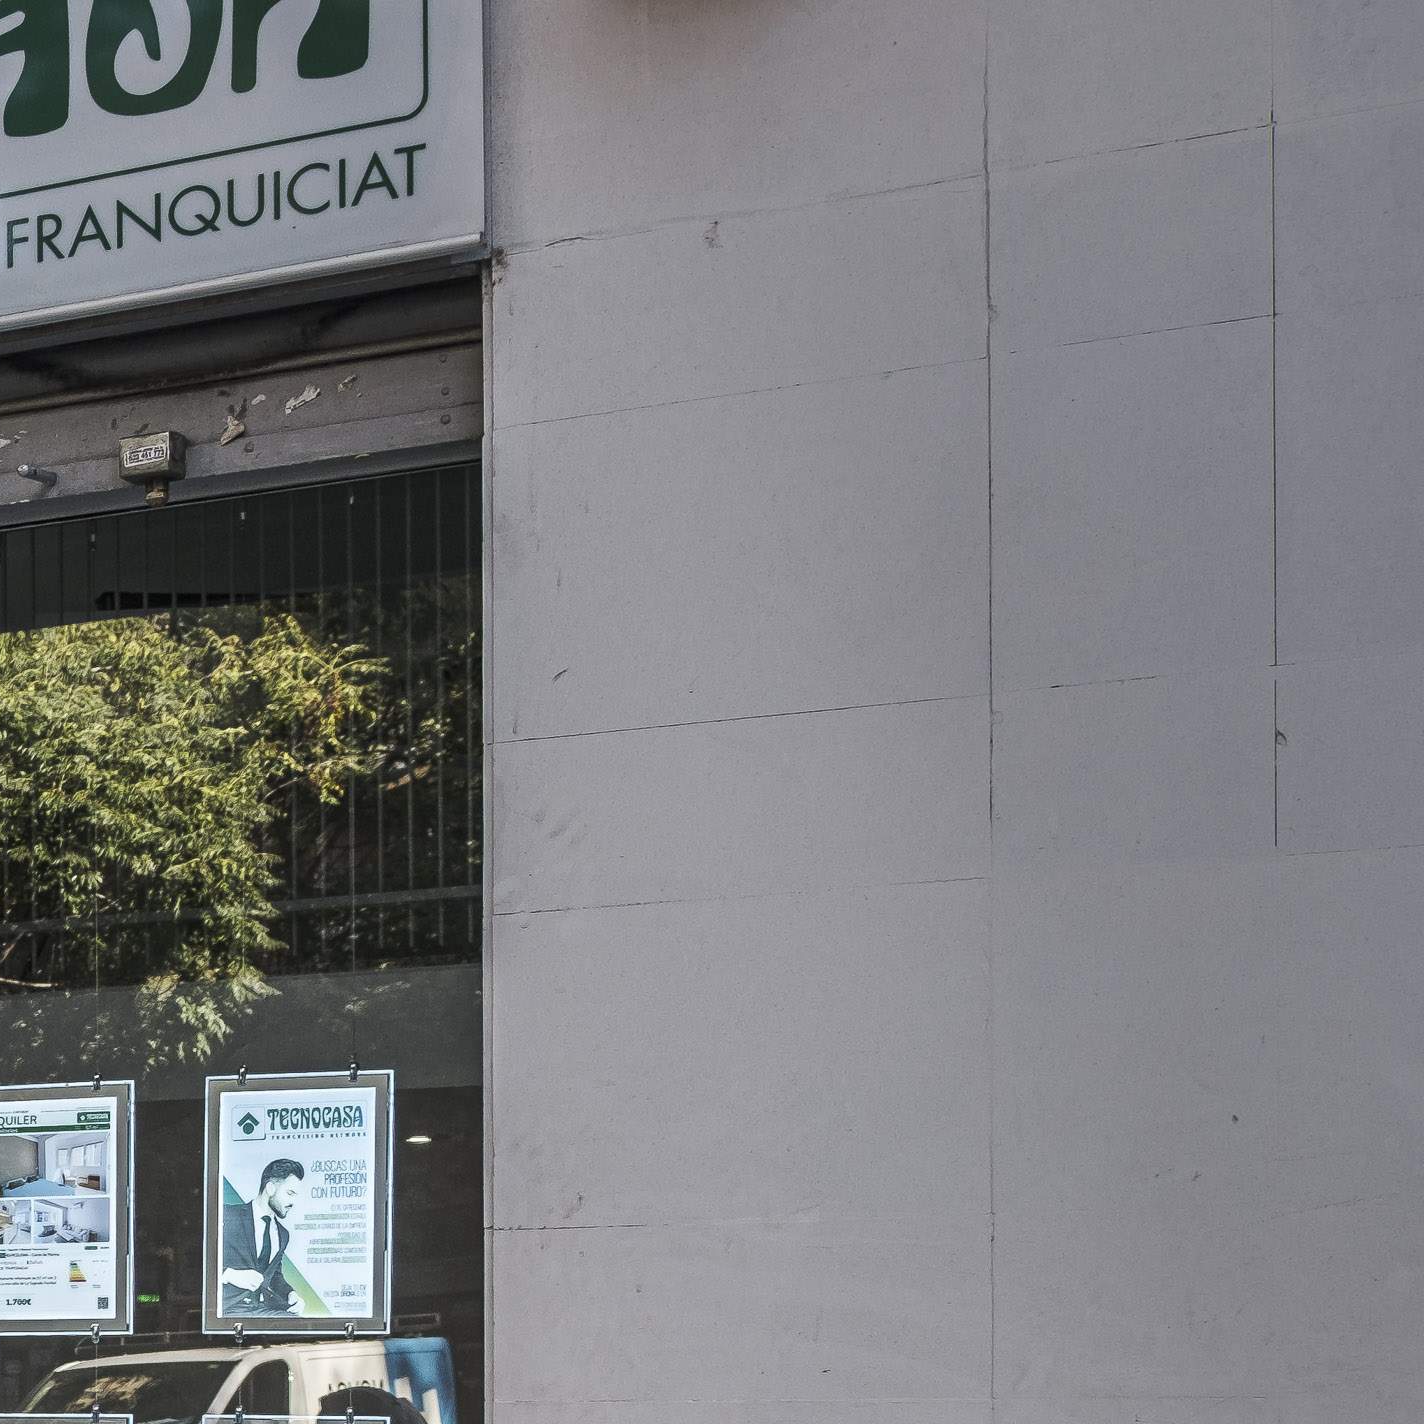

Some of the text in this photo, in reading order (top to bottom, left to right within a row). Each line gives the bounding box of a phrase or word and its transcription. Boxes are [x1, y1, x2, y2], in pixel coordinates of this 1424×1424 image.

[5, 144, 428, 269] FRANQUICIAT
[267, 1106, 364, 1130] TECNOCASA
[311, 1187, 327, 1198] CON
